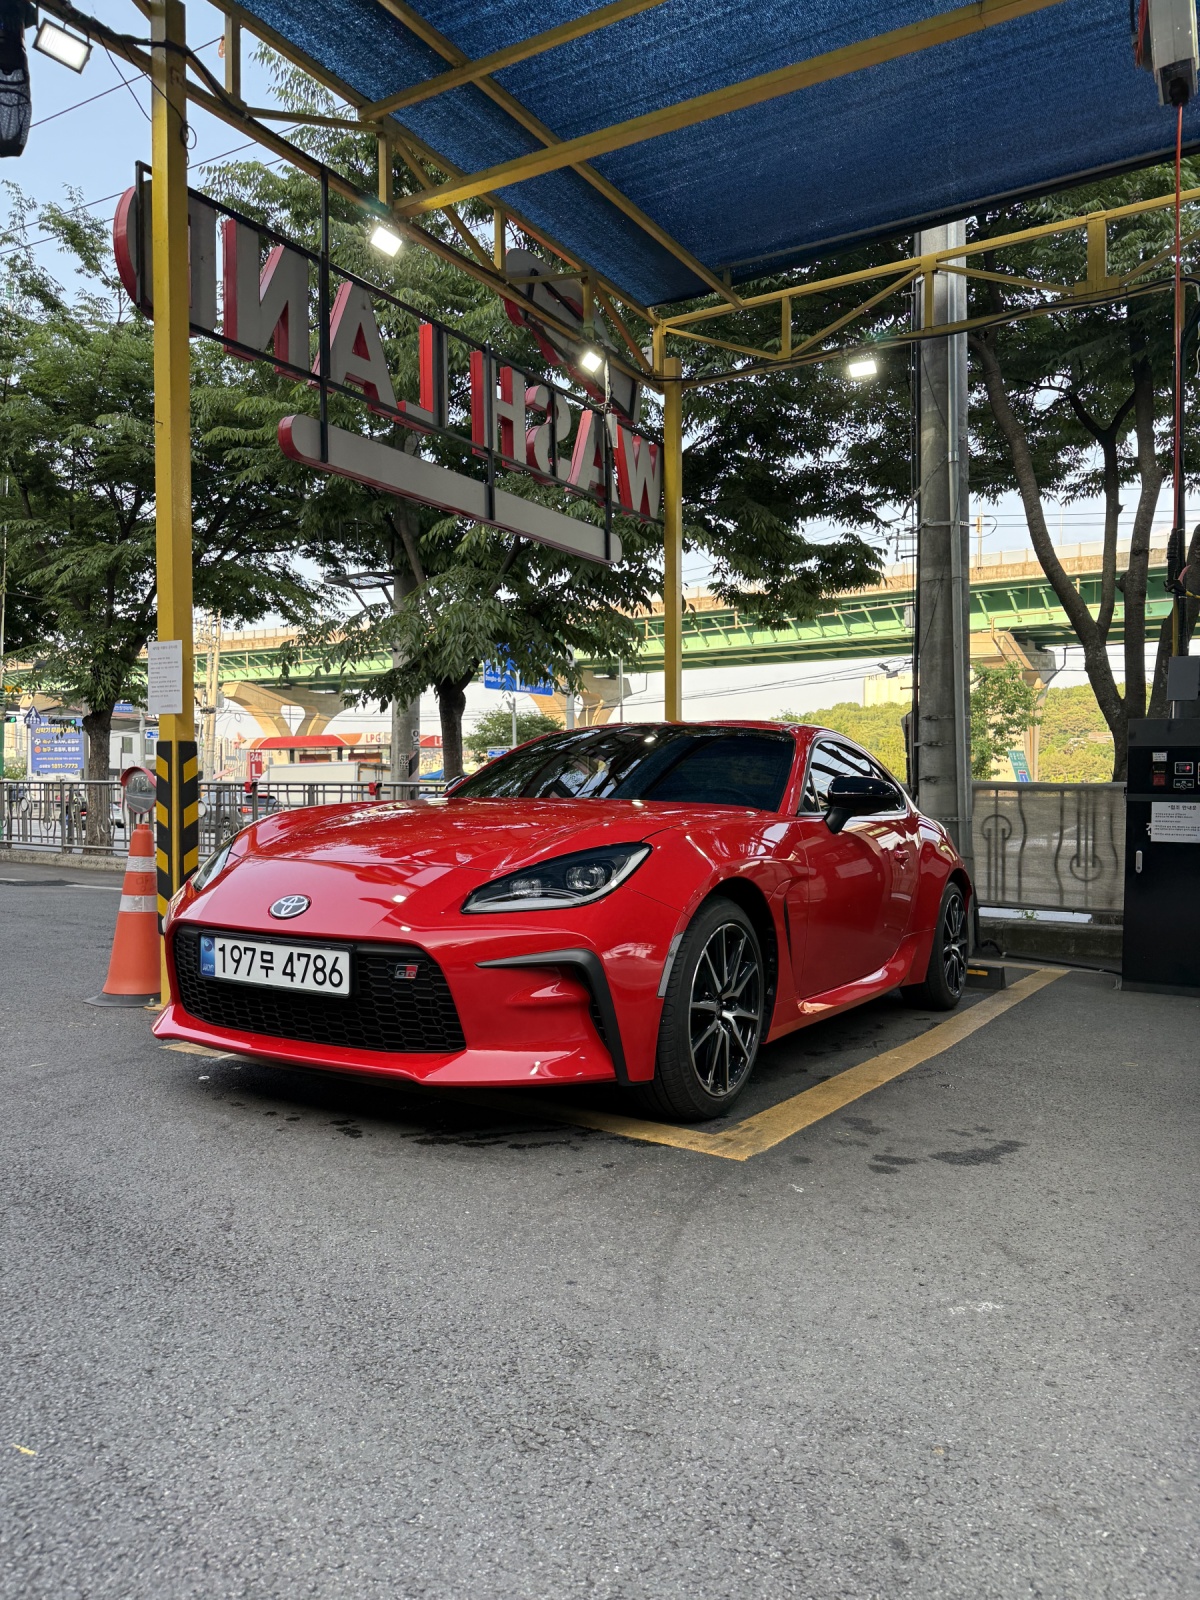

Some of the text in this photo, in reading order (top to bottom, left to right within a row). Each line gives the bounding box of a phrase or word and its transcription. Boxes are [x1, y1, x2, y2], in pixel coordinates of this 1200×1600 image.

[366, 733, 381, 744] LPG
[434, 736, 443, 746] LP
[218, 943, 344, 988] 197무 4786
[396, 969, 417, 977] GR
